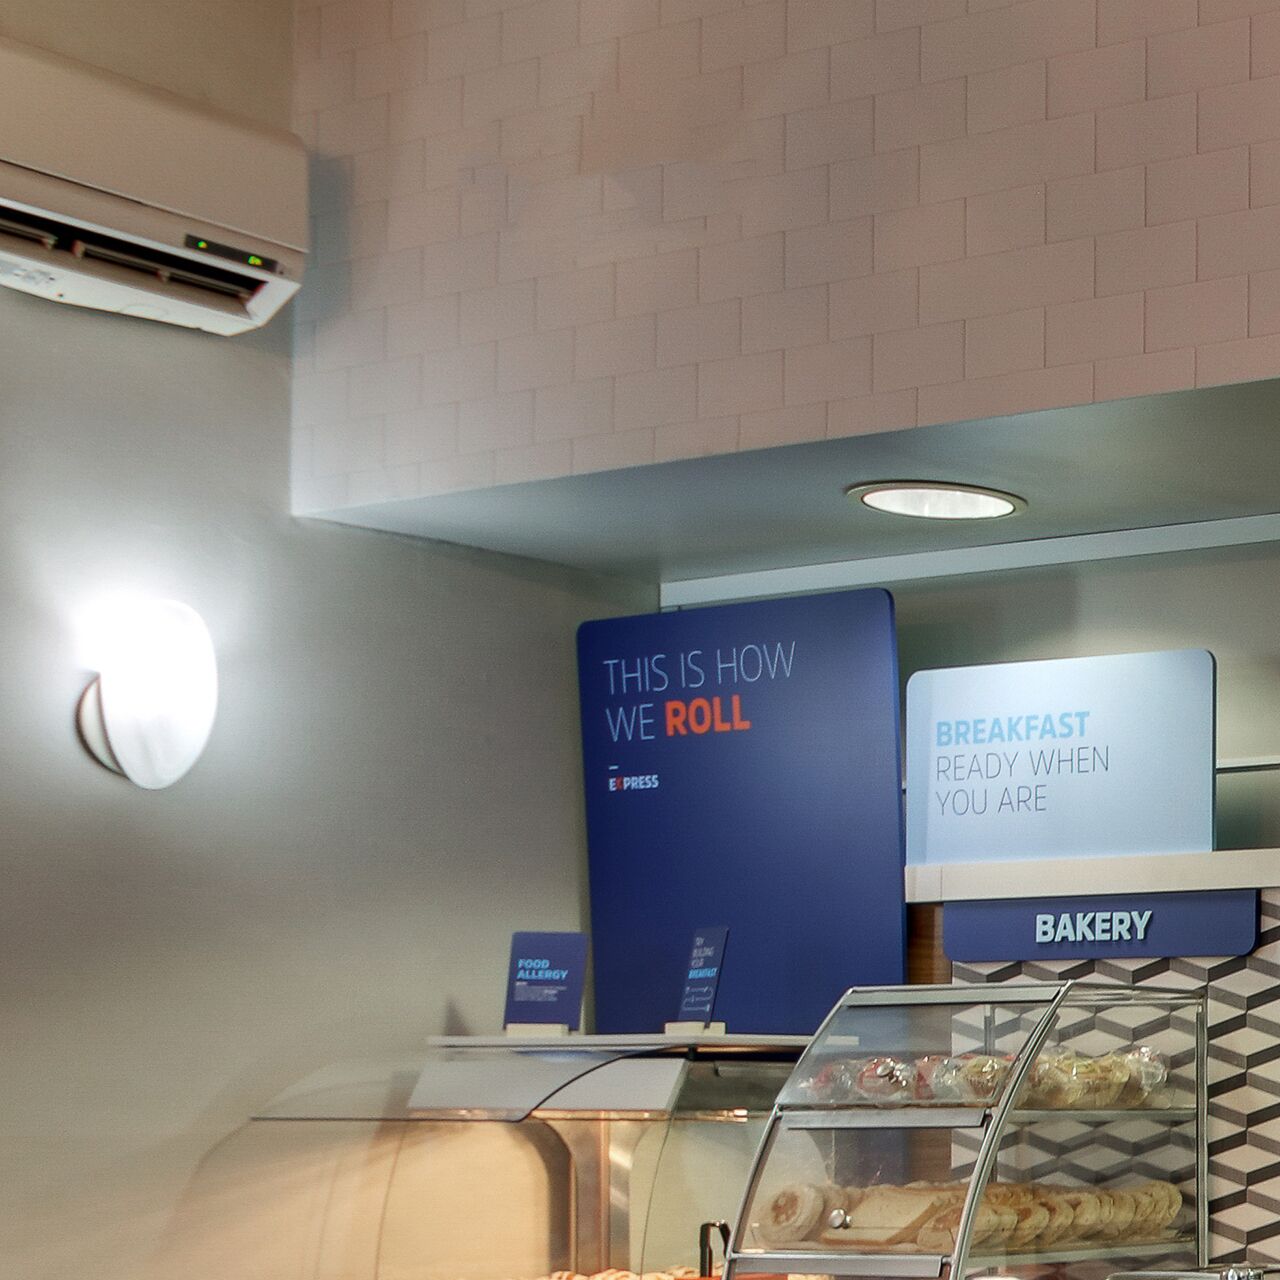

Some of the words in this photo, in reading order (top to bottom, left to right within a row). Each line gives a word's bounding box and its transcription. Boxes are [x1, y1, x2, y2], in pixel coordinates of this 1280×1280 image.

[603, 654, 669, 696] THIS
[680, 650, 705, 689] IS
[717, 640, 796, 685] HOW
[605, 703, 655, 743] WE
[664, 694, 751, 737] ROLL
[936, 710, 1090, 747] BREAKFAST
[936, 751, 1019, 782] READY
[1029, 745, 1110, 777] WHEN
[608, 774, 660, 792] EXPRESS
[935, 786, 988, 816] YOU
[998, 784, 1047, 813] ARE
[1035, 910, 1153, 943] BAKERY
[517, 969, 568, 981] ALLERGY
[518, 958, 550, 969] FOOD
